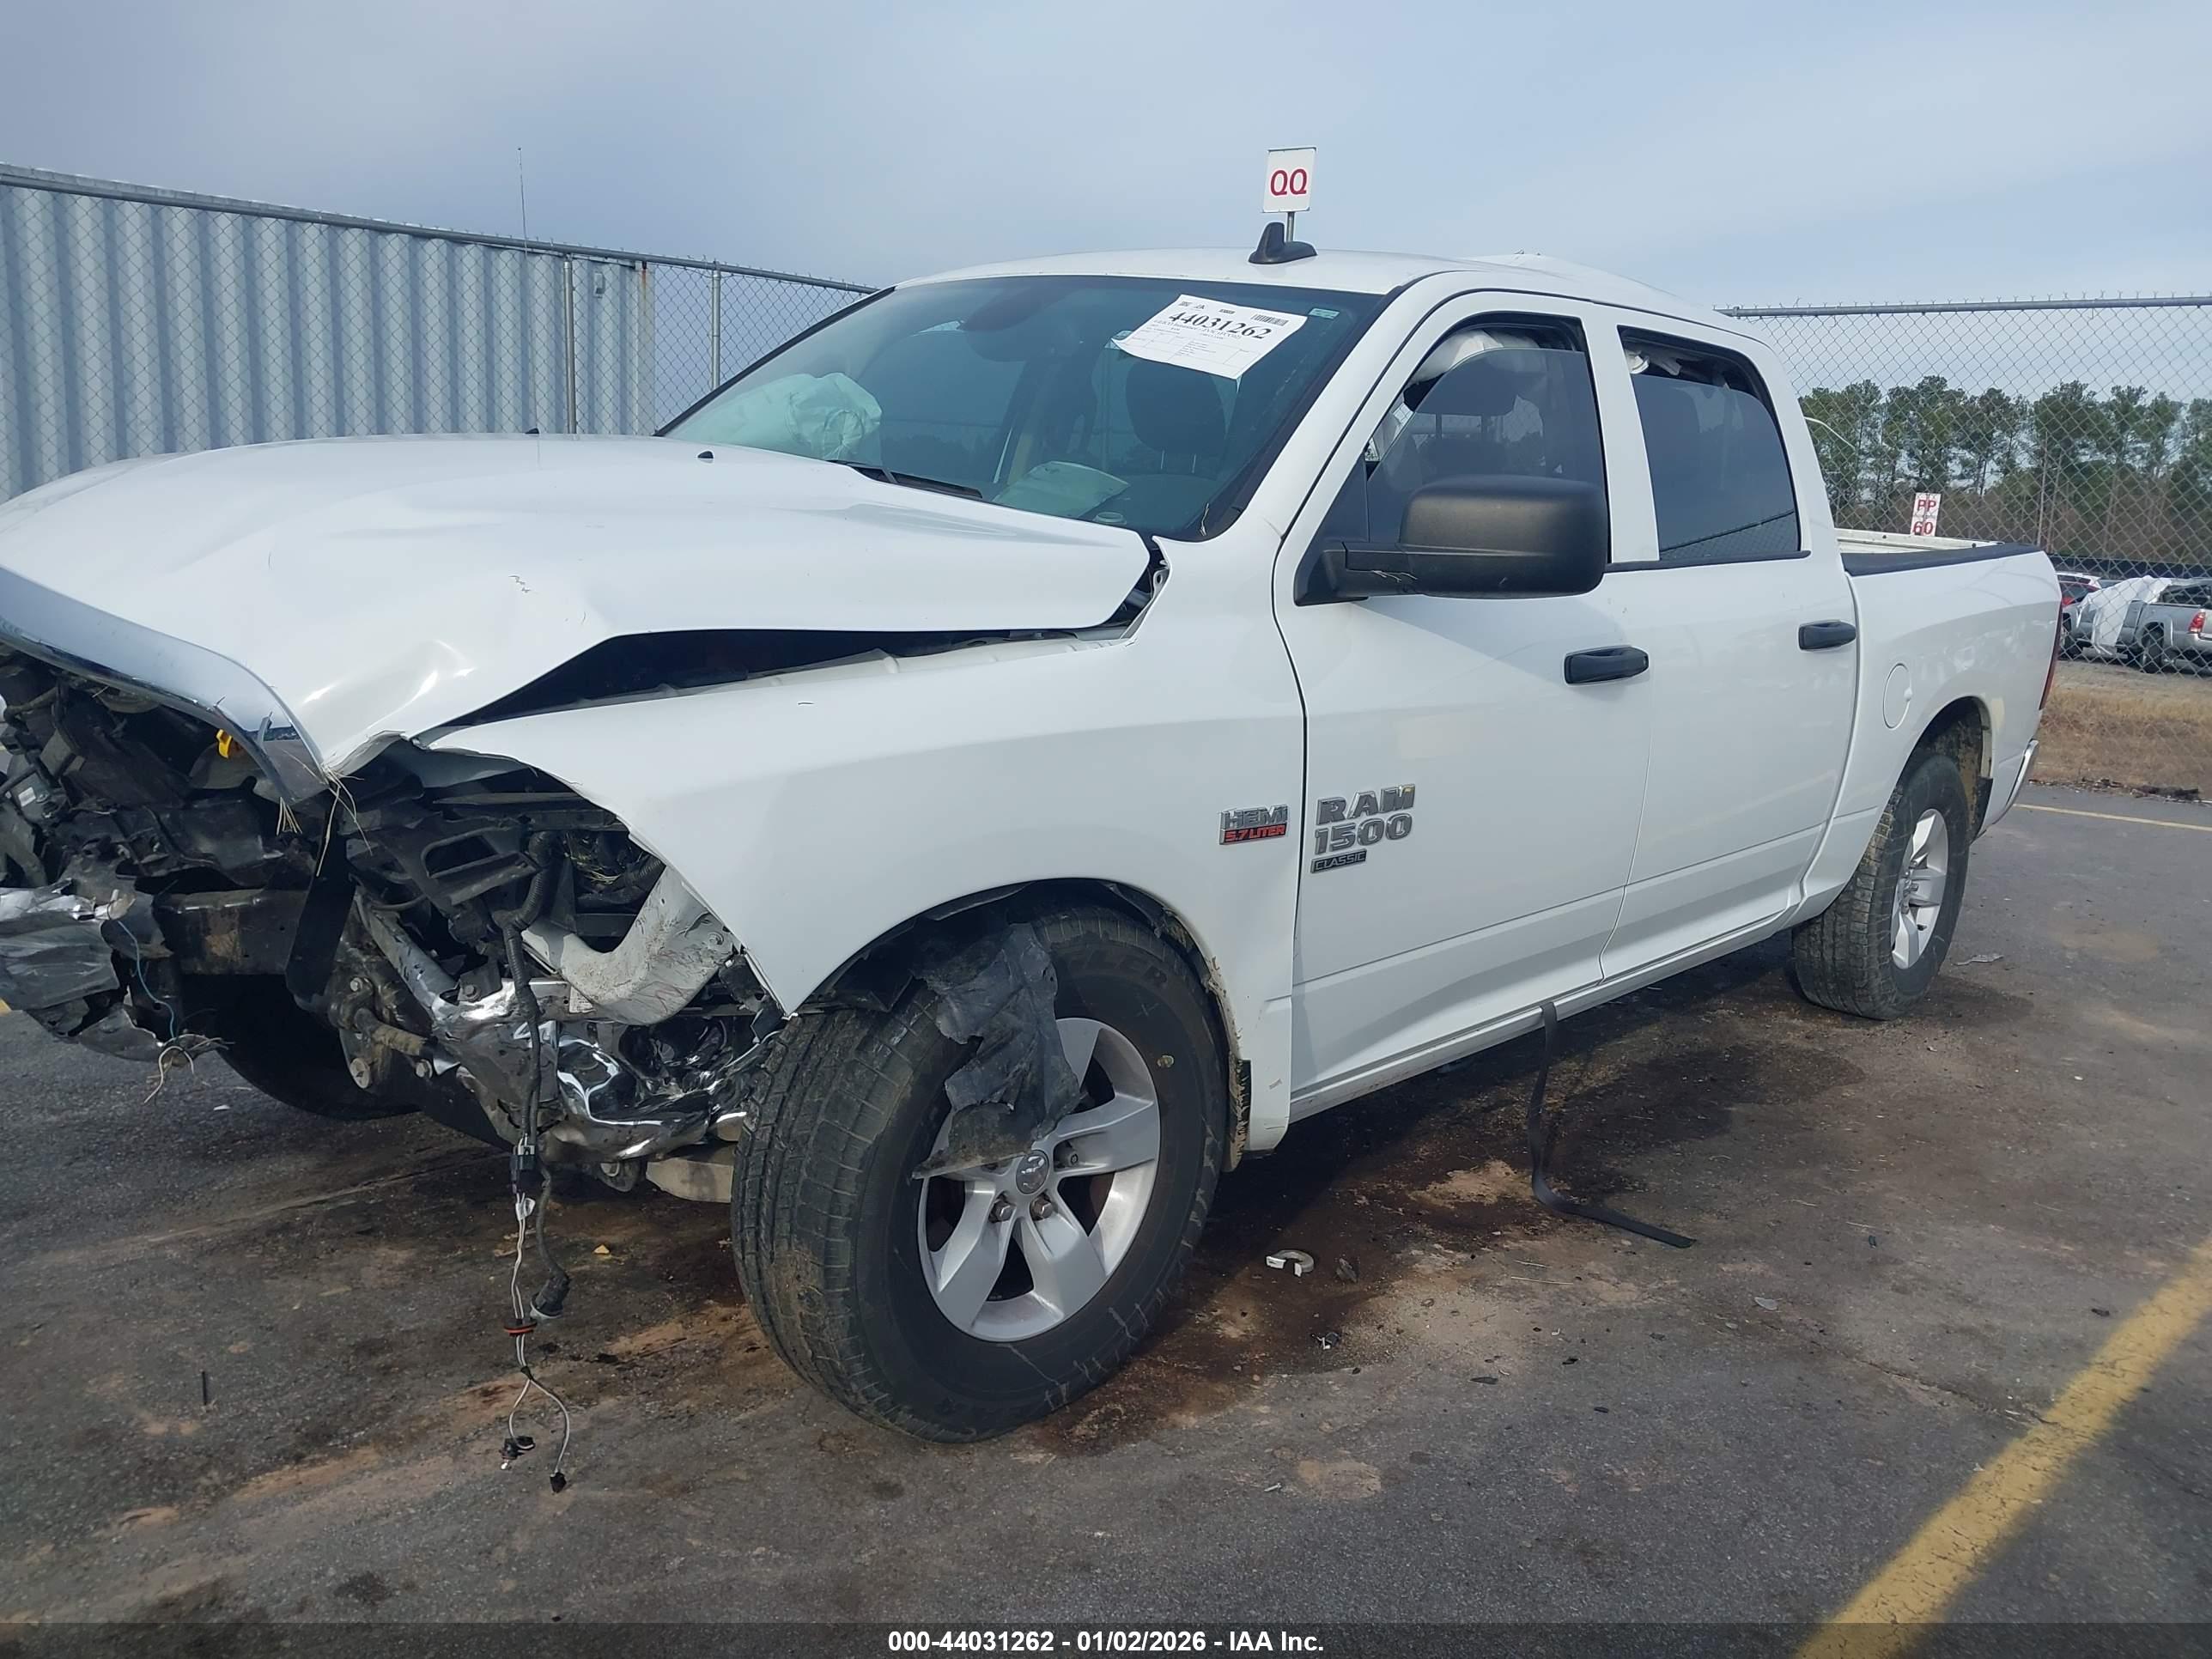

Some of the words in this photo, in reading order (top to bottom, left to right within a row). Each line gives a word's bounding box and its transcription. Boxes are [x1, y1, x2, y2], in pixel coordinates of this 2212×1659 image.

[1270, 168, 1307, 196] QQ
[1169, 311, 1272, 339] 44031262
[1917, 499, 1936, 512] PP
[1912, 520, 1933, 536] 60
[1219, 804, 1288, 830] HEMI
[1316, 783, 1415, 825] RAM
[1315, 812, 1413, 855] 1500
[1316, 849, 1367, 872] CLASSIC
